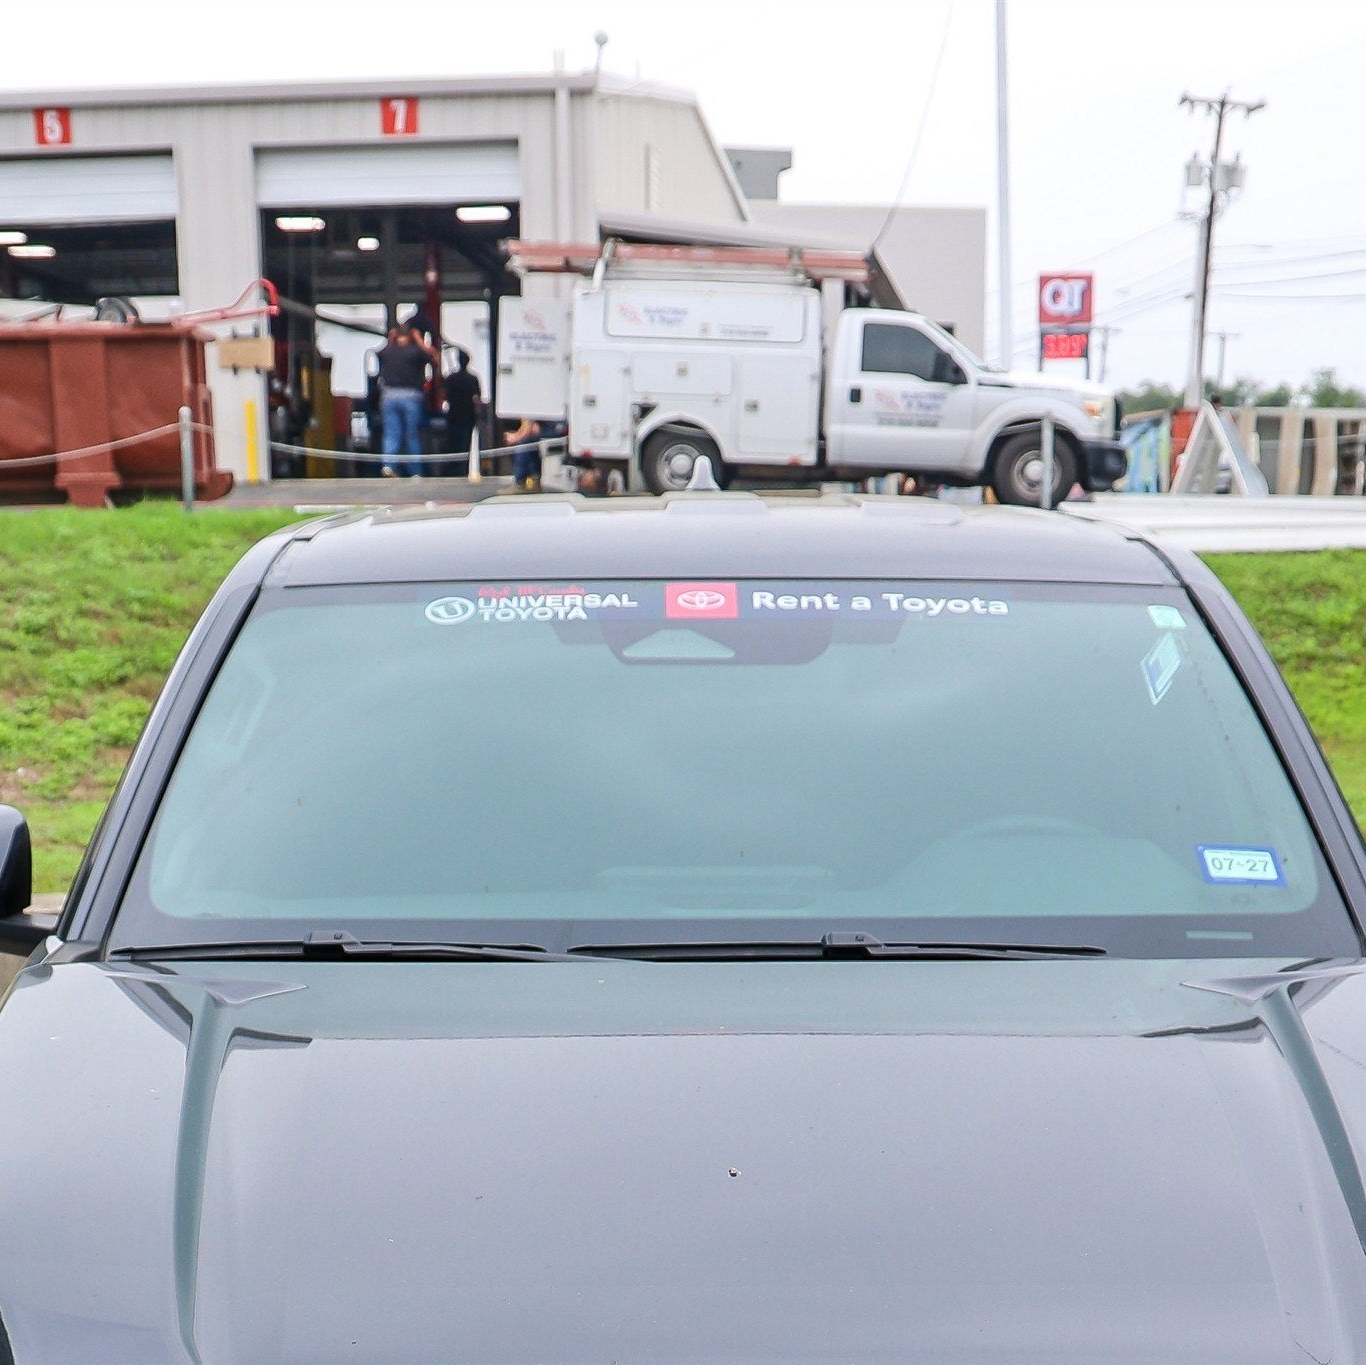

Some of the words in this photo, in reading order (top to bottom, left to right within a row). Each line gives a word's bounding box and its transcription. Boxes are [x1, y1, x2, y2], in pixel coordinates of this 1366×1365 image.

[43, 110, 64, 142] 5
[389, 99, 407, 132] 7
[1041, 278, 1088, 317] QT
[478, 593, 638, 609] UNIVERSAL
[480, 607, 588, 623] TOYOTA
[752, 591, 840, 611] Rent
[850, 595, 872, 611] a
[882, 592, 1009, 617] Toyota
